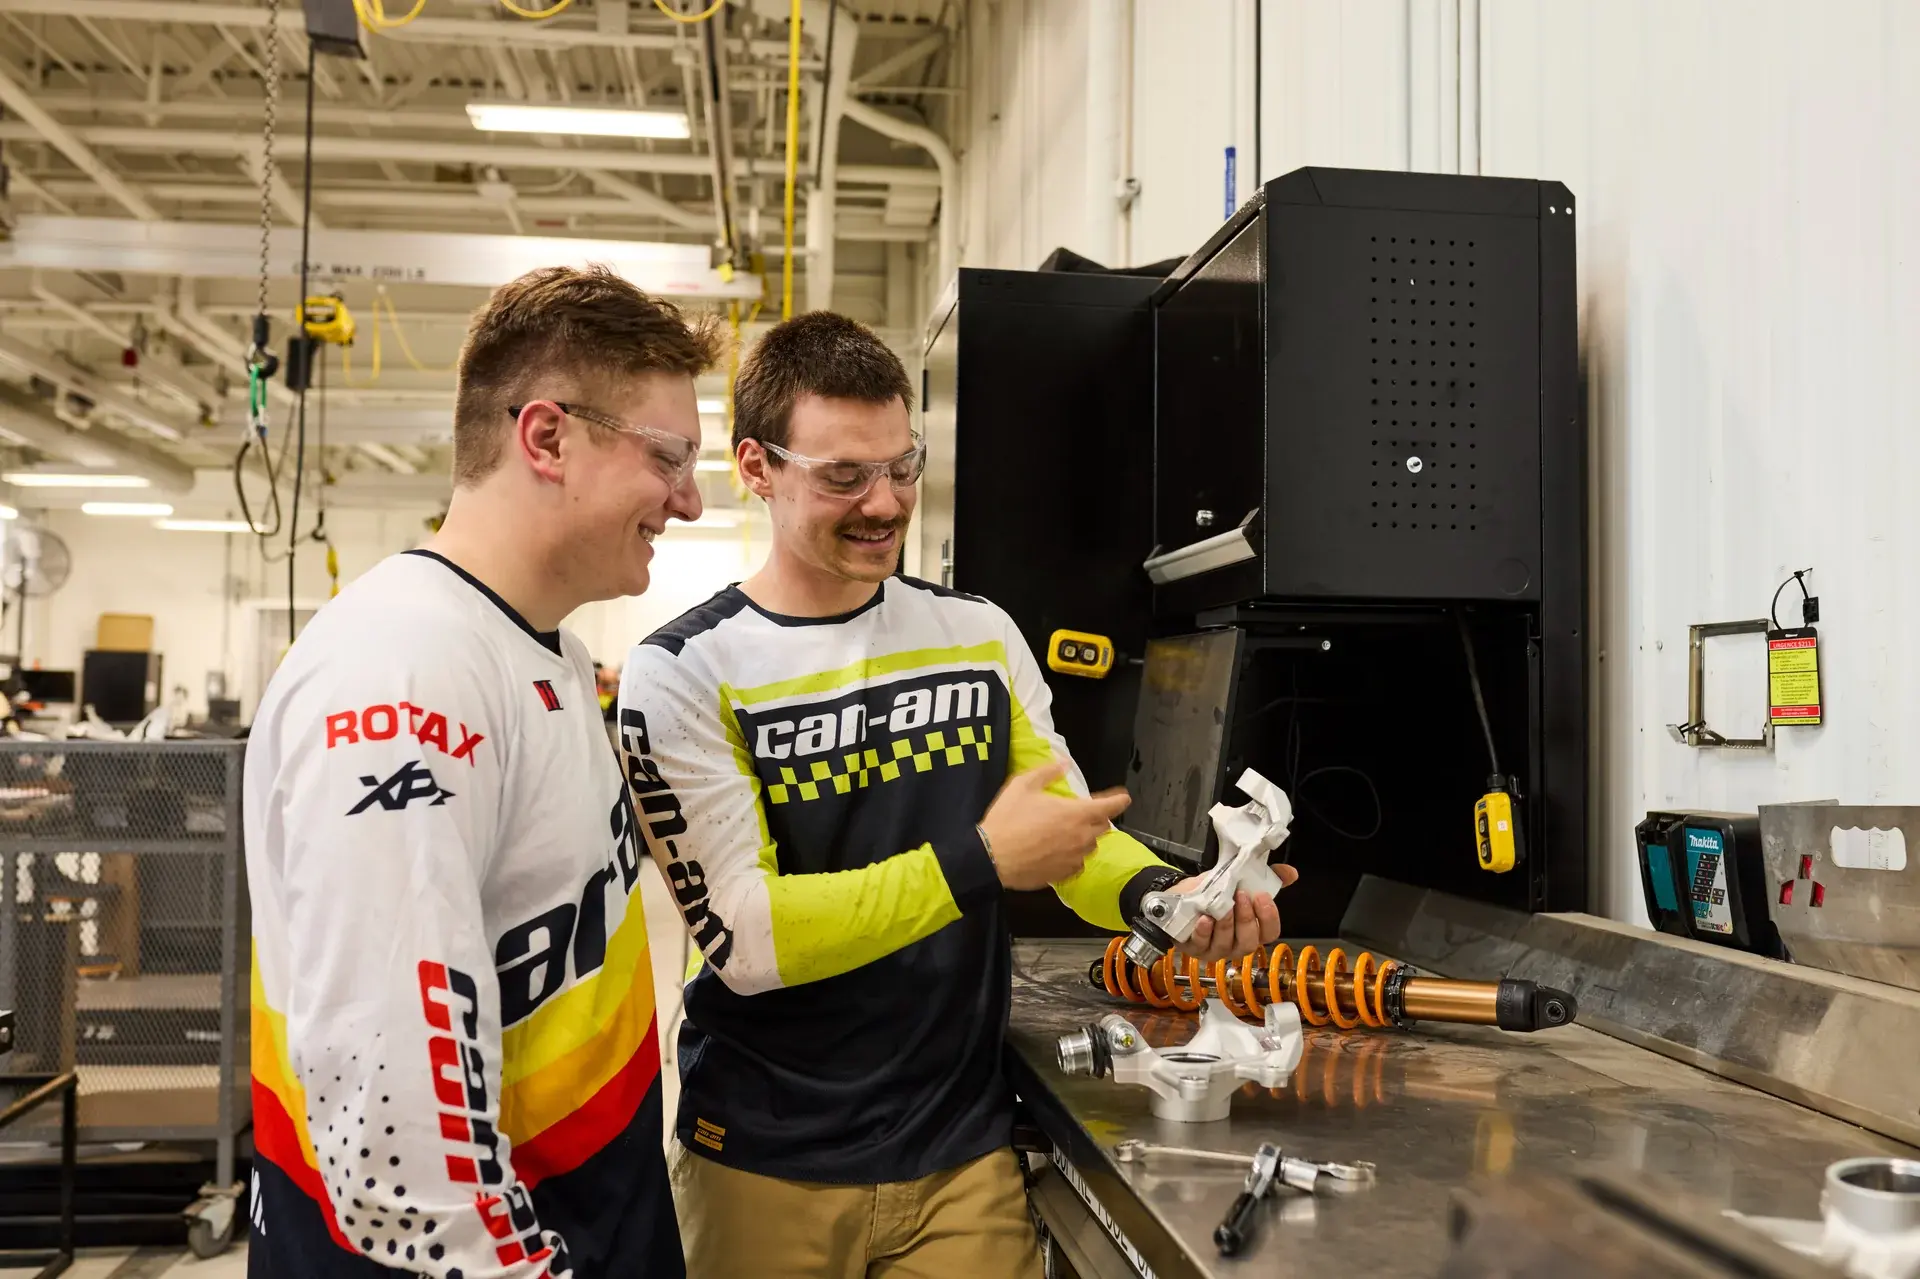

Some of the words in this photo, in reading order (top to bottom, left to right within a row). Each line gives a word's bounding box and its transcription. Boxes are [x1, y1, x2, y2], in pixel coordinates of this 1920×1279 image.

[326, 701, 486, 768] ROTAX
[755, 681, 990, 760] can-am
[621, 708, 734, 971] can-am
[1689, 834, 1720, 850] Makita
